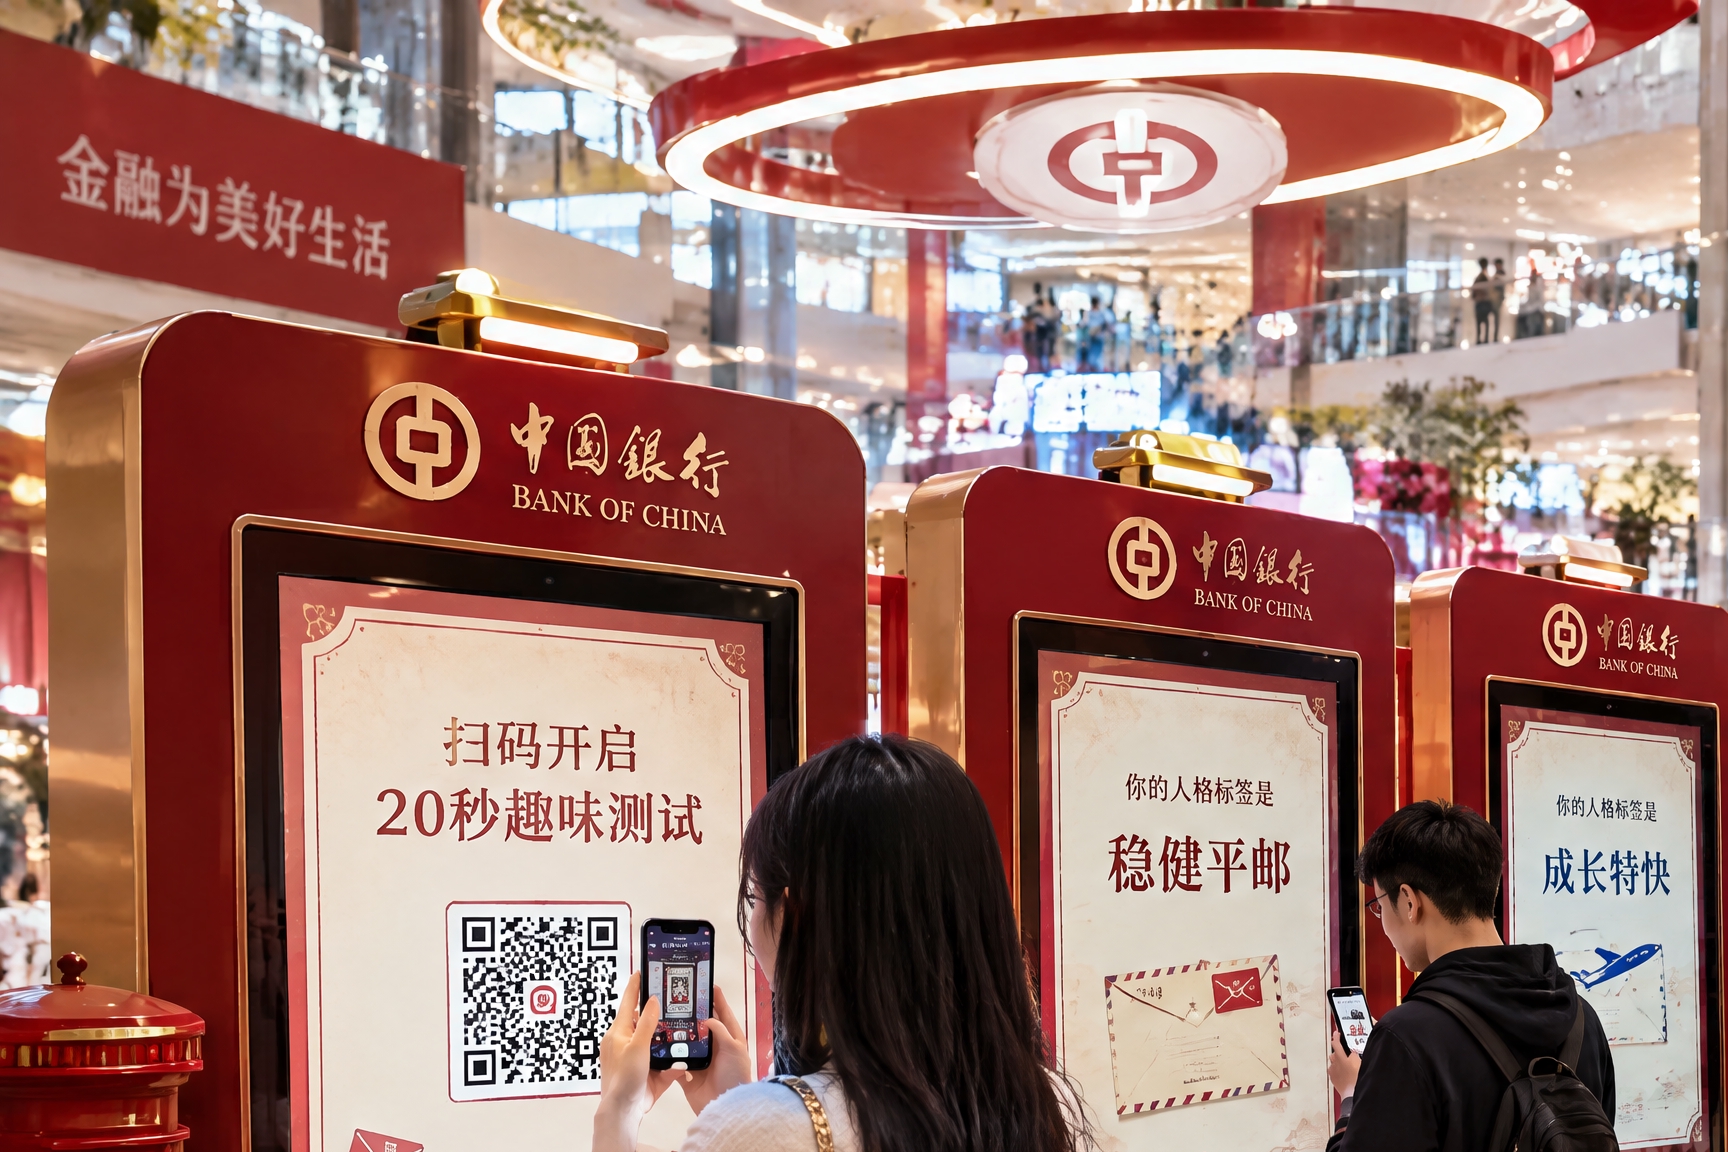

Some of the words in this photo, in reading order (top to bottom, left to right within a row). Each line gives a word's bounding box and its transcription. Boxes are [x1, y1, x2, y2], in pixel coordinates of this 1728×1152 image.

[56, 133, 392, 282] 金融为美好生活
[512, 484, 592, 517] BANK
[600, 498, 635, 523] OF
[642, 504, 727, 536] CHINA
[1194, 588, 1238, 610] BANK
[1242, 596, 1262, 613] OF
[1266, 600, 1313, 621] CHINA
[1599, 657, 1627, 672] BANK
[1630, 661, 1644, 674] OF
[1646, 663, 1678, 679] CHINA
[443, 716, 638, 773] 扫码开启
[376, 786, 704, 845] 20秒趣味测试
[1125, 773, 1274, 807] 你的人格标签是
[1556, 794, 1657, 823] 你的人格标签是
[1107, 833, 1292, 895] 稳健平邮
[1542, 847, 1671, 897] 成长特快
